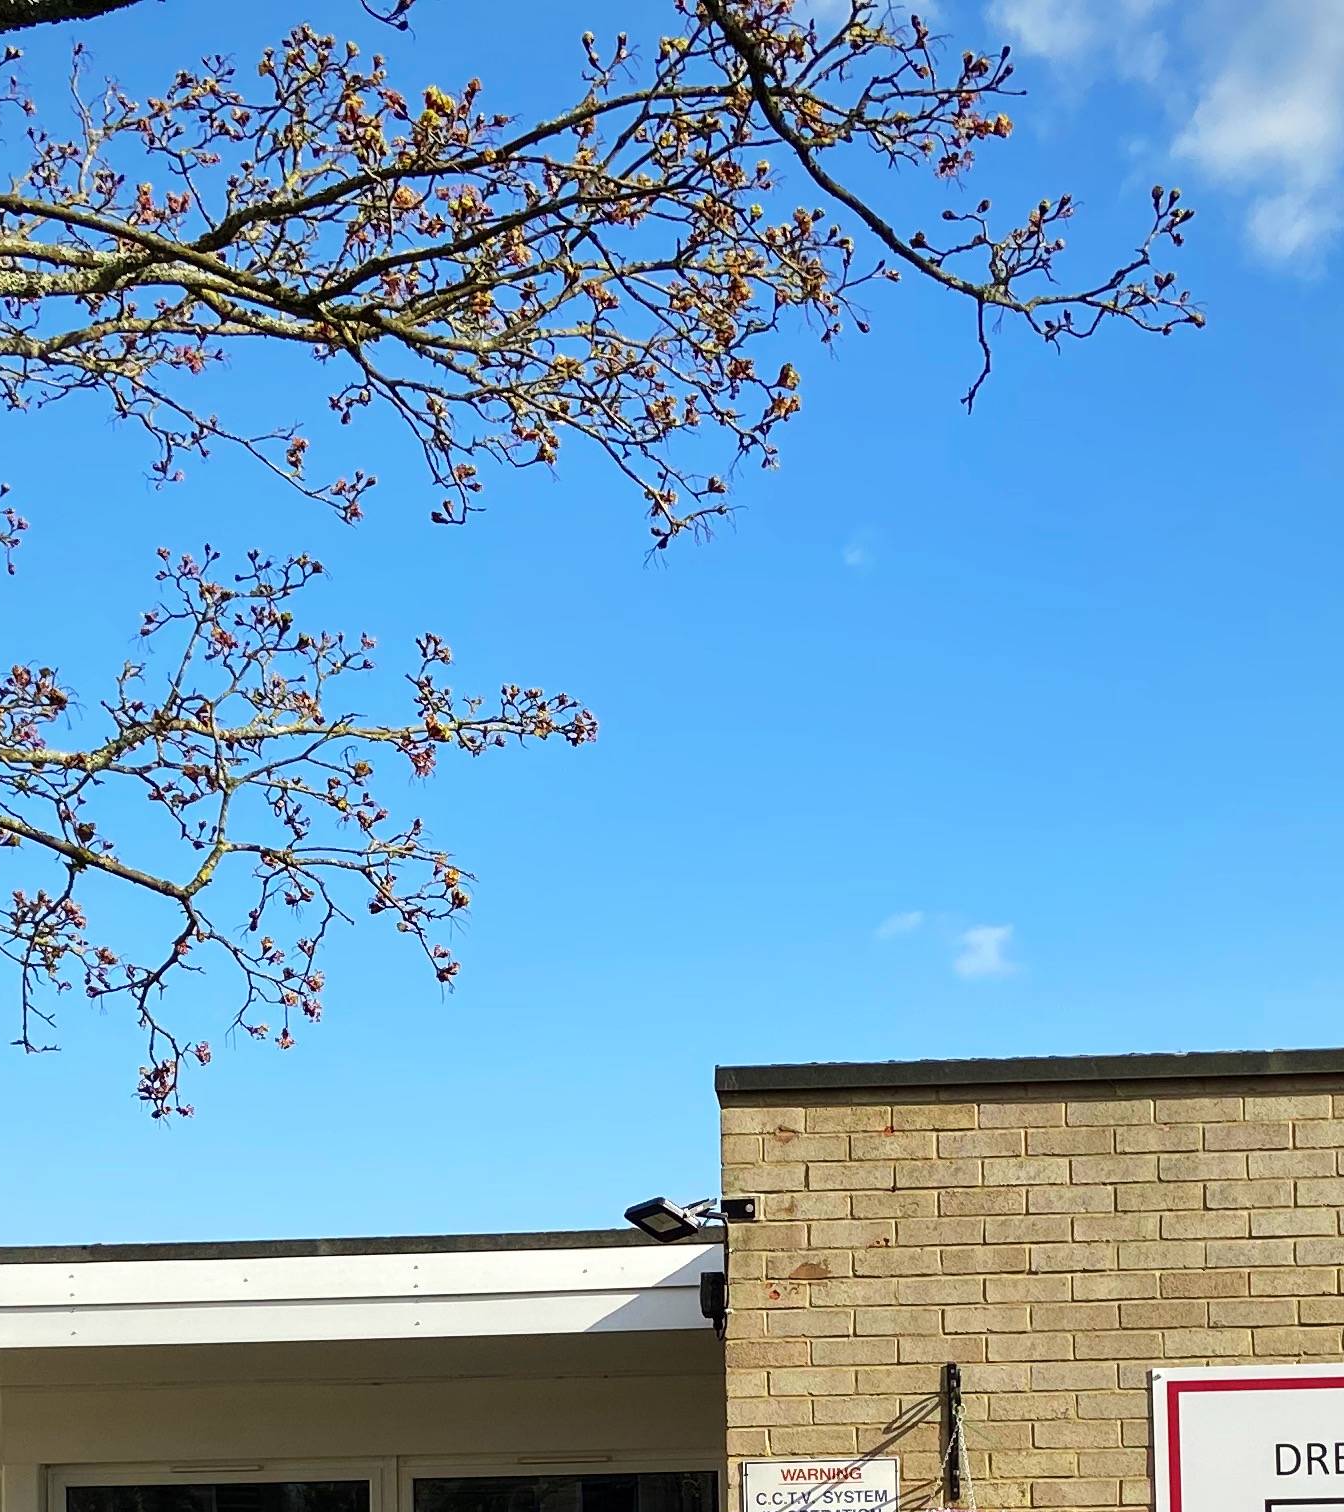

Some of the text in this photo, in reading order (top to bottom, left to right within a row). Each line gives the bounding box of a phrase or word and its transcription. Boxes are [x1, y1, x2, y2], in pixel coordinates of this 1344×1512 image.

[780, 1467, 863, 1482] WARNING
[756, 1489, 888, 1506] C.C.T.V. SYSTEM
